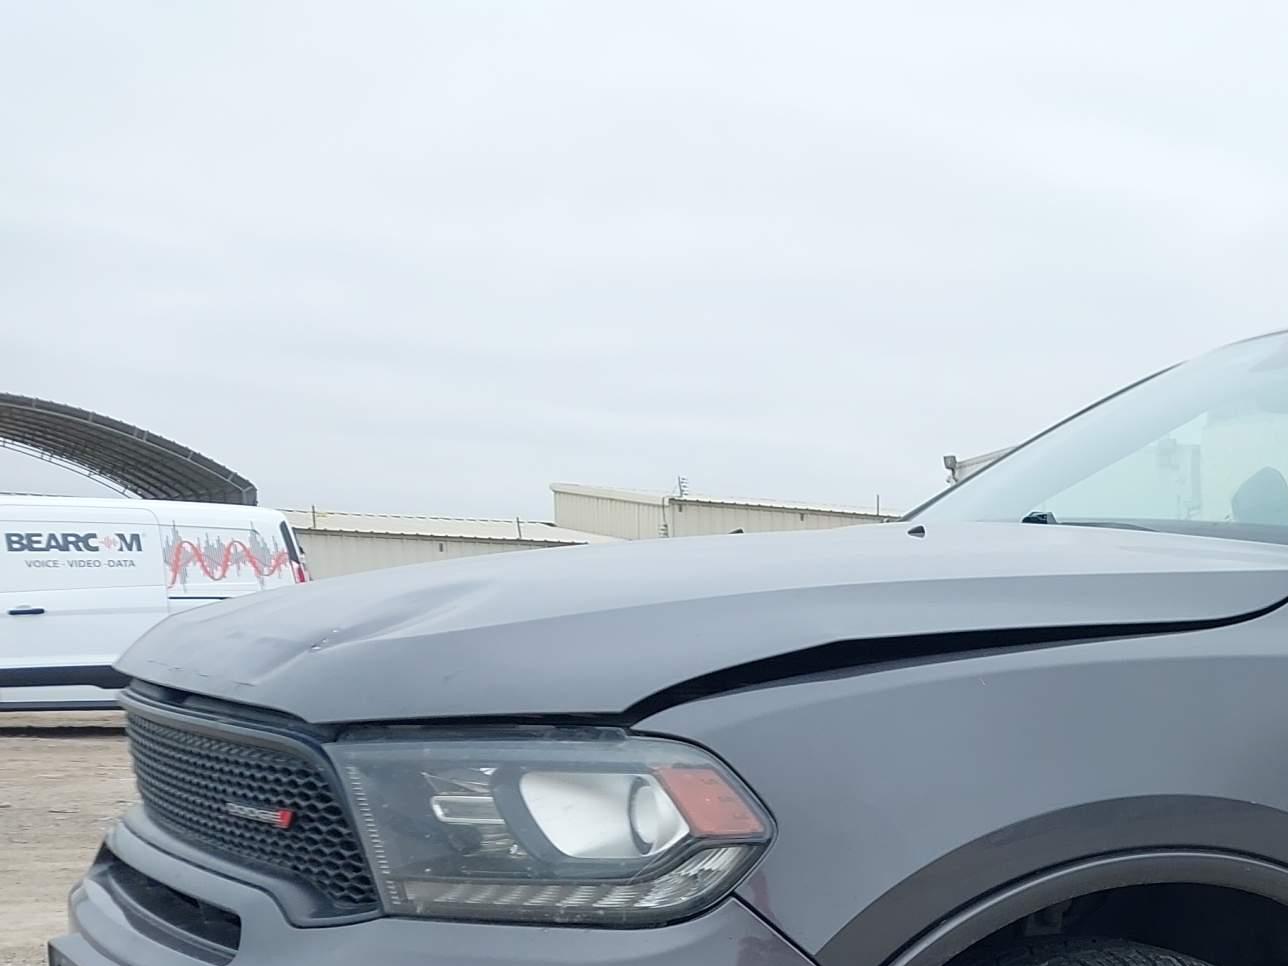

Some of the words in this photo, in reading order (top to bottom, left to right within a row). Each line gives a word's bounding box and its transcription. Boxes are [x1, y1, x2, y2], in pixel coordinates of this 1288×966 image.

[25, 559, 61, 568] VOICE
[67, 559, 102, 568] VIDEO
[107, 559, 136, 568] DATA
